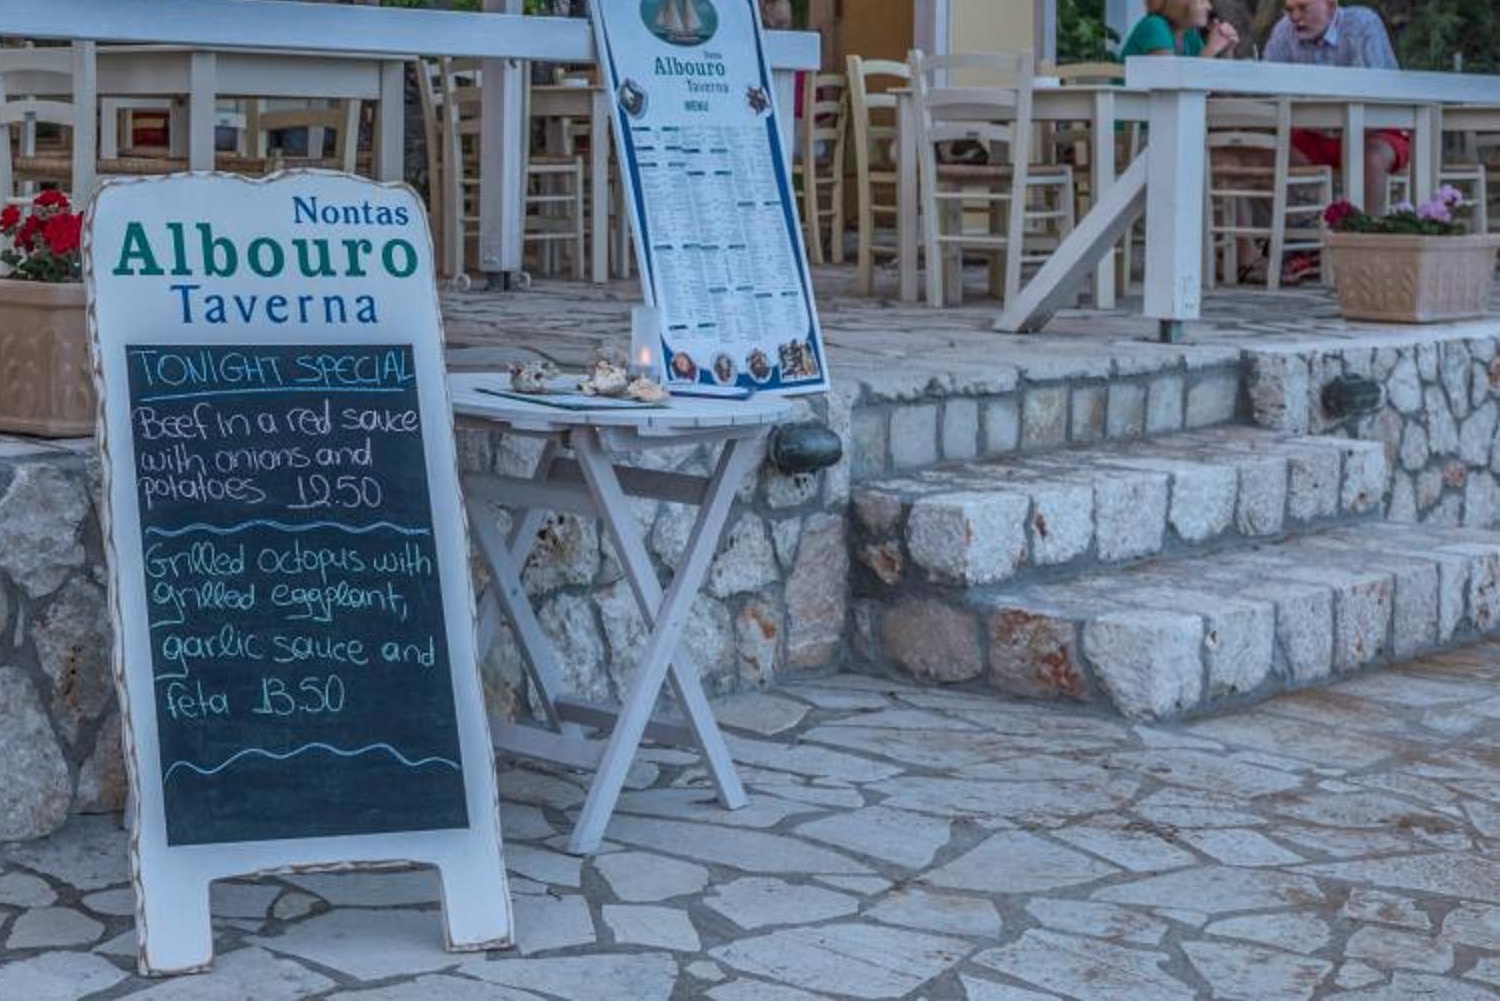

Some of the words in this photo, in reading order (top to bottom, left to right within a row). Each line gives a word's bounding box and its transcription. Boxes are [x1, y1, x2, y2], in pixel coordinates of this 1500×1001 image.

[654, 56, 725, 76] Albouro
[292, 196, 410, 226] Nontas
[112, 221, 419, 279] Albouro
[170, 284, 379, 324] Taverna
[132, 349, 284, 387] TONIGHT
[294, 351, 416, 385] SPECIAL
[132, 402, 212, 440] Beef
[257, 412, 279, 434] a
[287, 399, 332, 435] red
[341, 408, 419, 432] sauce
[140, 442, 207, 475] with
[315, 437, 373, 466] and
[139, 471, 268, 510] potatoes
[286, 473, 382, 509] 12.50
[145, 541, 245, 578] Grilled
[373, 541, 432, 576] with
[150, 581, 256, 628] grilled
[153, 623, 264, 680] garlic
[273, 635, 370, 665] sauce
[381, 635, 436, 667] and
[252, 673, 345, 716] 13.50
